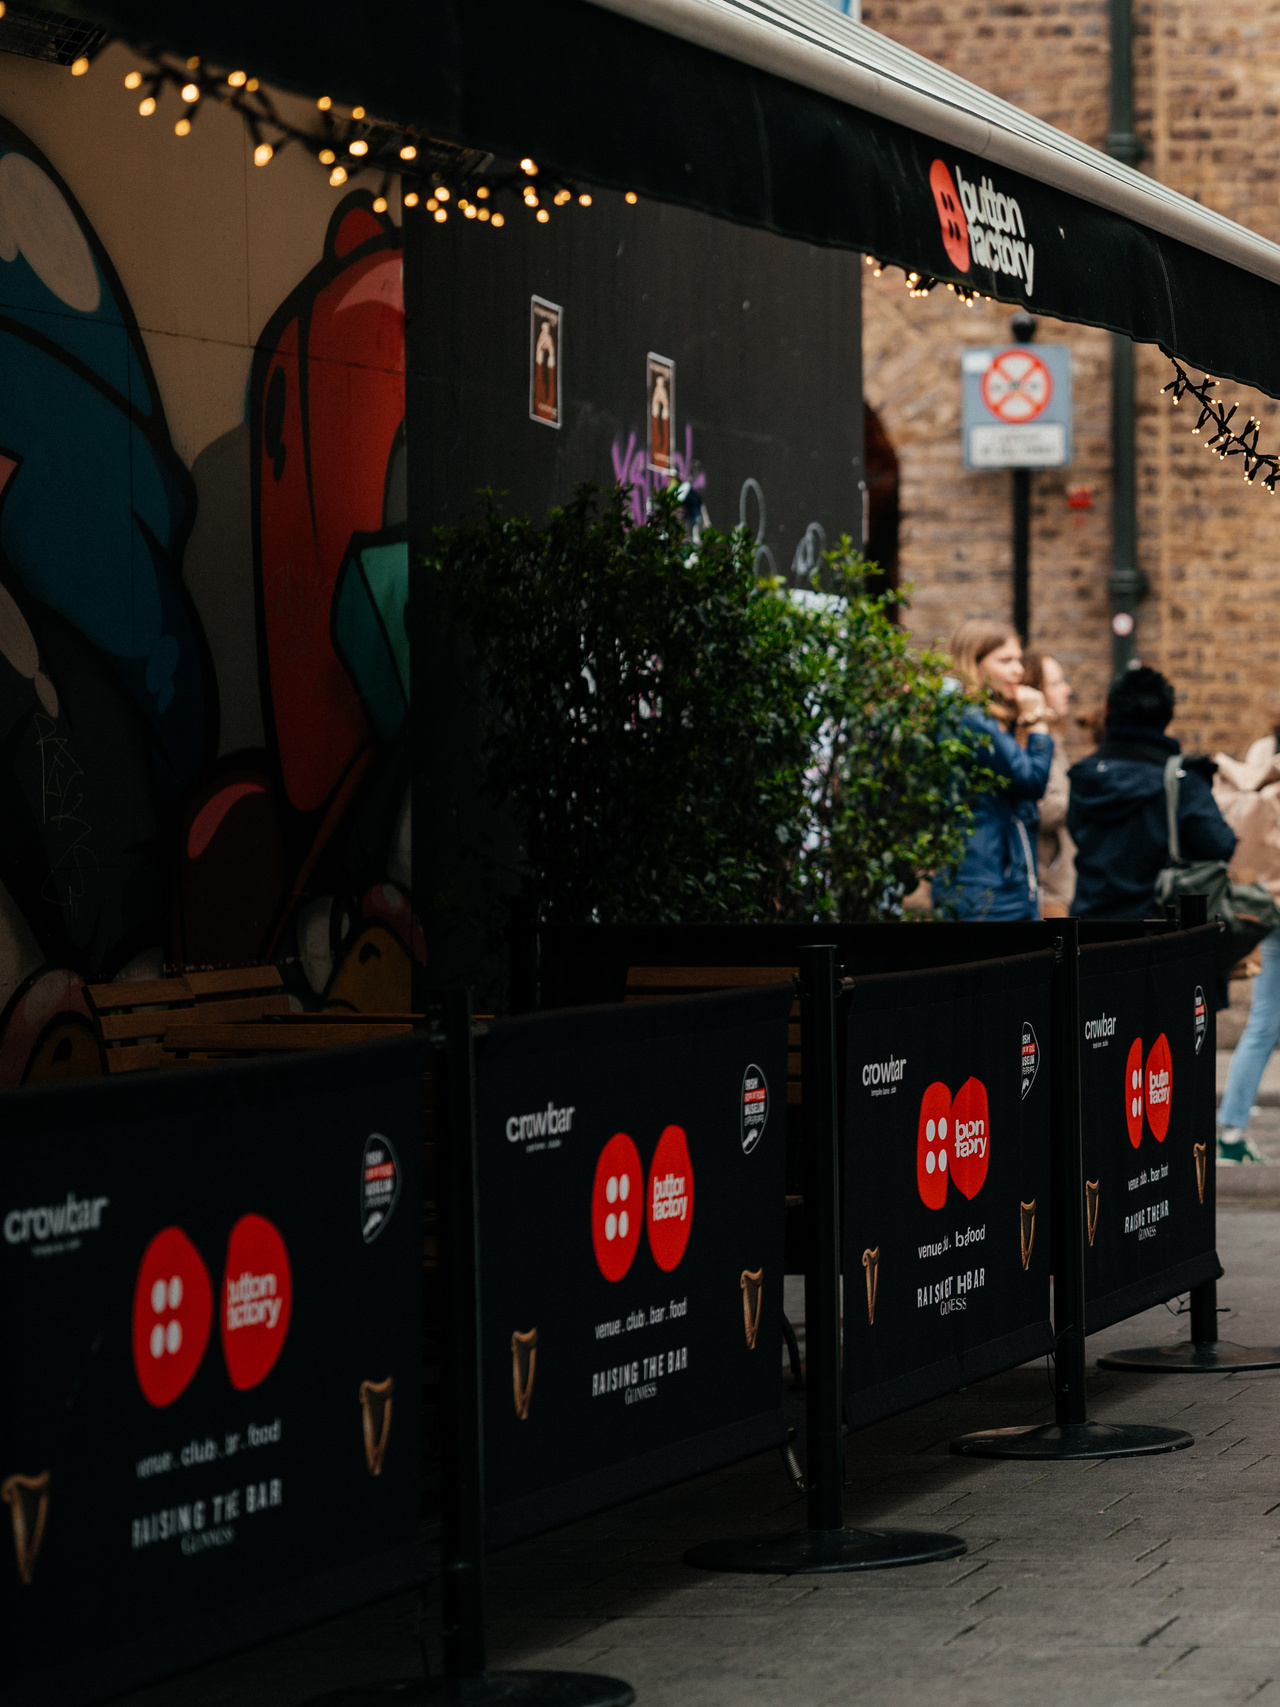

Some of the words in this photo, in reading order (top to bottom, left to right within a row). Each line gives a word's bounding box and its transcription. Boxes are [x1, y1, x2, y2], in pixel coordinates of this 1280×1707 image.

[956, 165, 1026, 238] button
[967, 224, 1034, 297] factory
[1084, 1012, 1117, 1040] crowbar
[862, 1053, 907, 1087] crowbar
[505, 1101, 576, 1143] crowbar
[956, 1119, 985, 1142] buon
[954, 1136, 987, 1158] faory
[1146, 1204, 1160, 1224] THE
[917, 1242, 942, 1259] venue
[955, 1230, 969, 1248] ba
[967, 1224, 986, 1243] food
[226, 1270, 278, 1307] utton
[917, 1278, 950, 1308] RAISNG
[966, 1268, 986, 1291] BAR
[595, 1318, 622, 1340] venue
[626, 1310, 646, 1332] club
[650, 1305, 666, 1325] bar
[669, 1296, 688, 1319] food
[592, 1360, 640, 1397] RAISING
[643, 1353, 665, 1381] THE
[667, 1346, 688, 1374] BAR
[625, 1381, 657, 1405] GUINNESS
[247, 1417, 282, 1447] food
[246, 1477, 283, 1514] BAR
